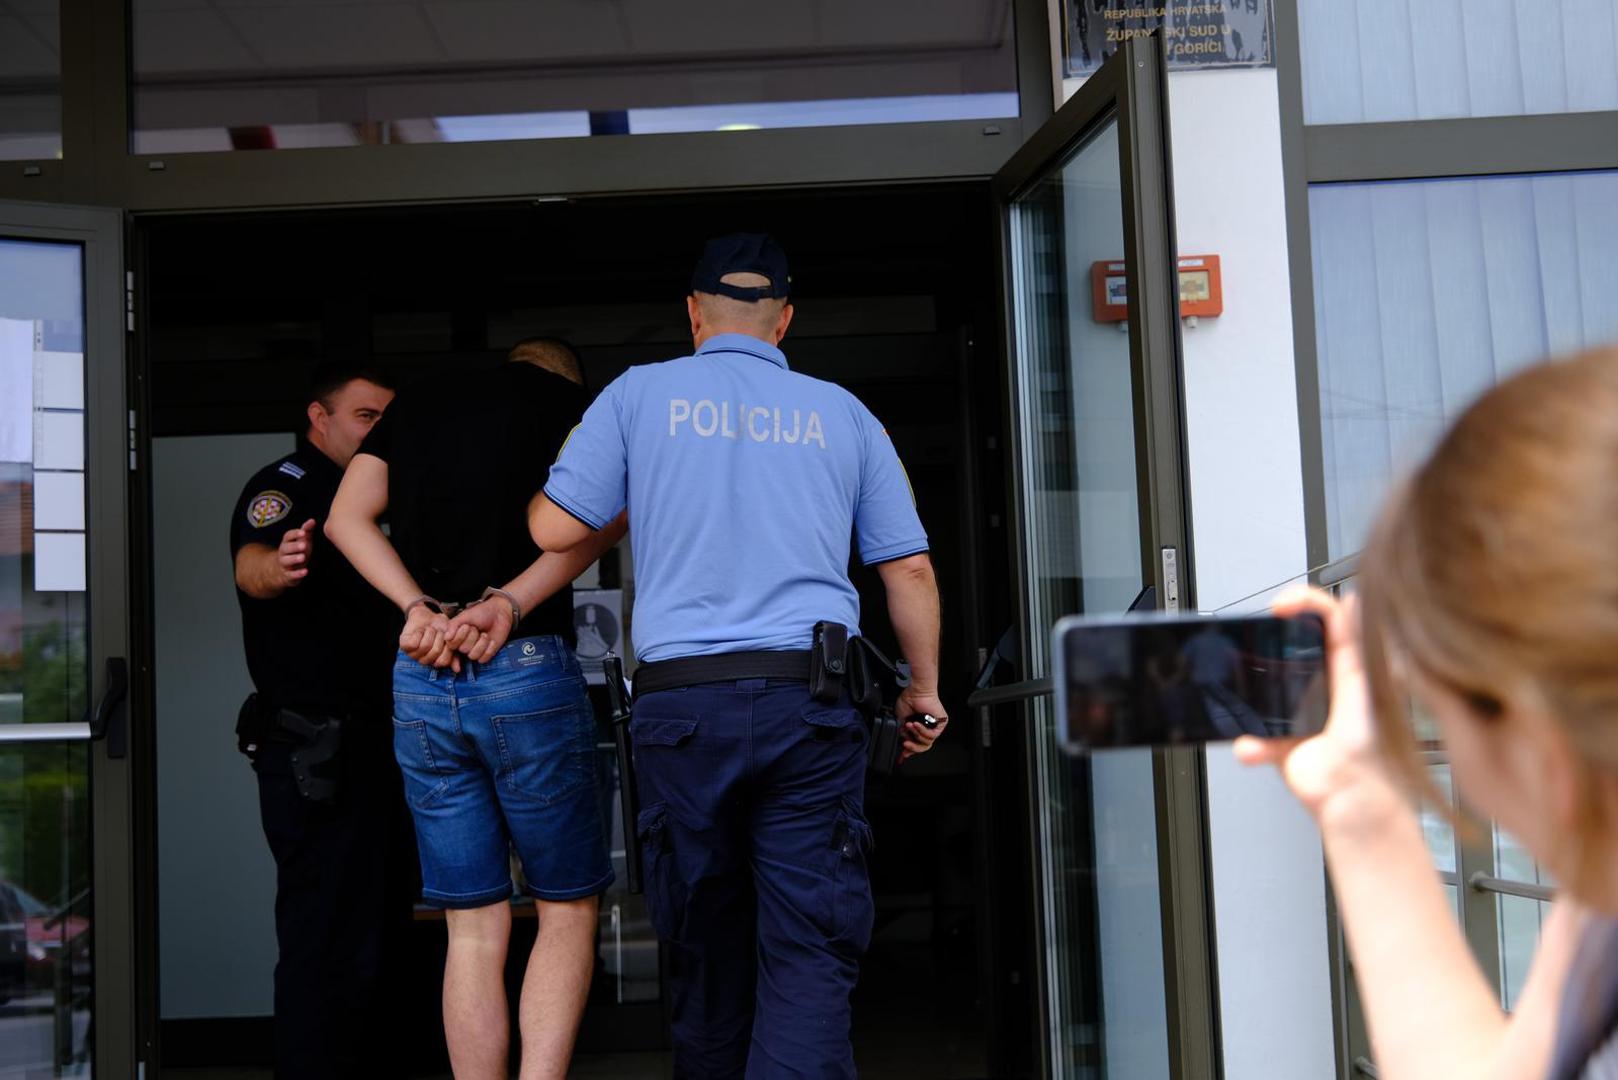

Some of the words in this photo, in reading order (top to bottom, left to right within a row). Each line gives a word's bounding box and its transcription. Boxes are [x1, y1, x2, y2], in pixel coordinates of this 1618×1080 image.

[1104, 7, 1166, 19] REPUBLIKA
[1171, 5, 1226, 16] HRVATSKA
[1189, 25, 1217, 37] SUD
[1220, 24, 1231, 35] U
[669, 399, 827, 449] POLICIJA
